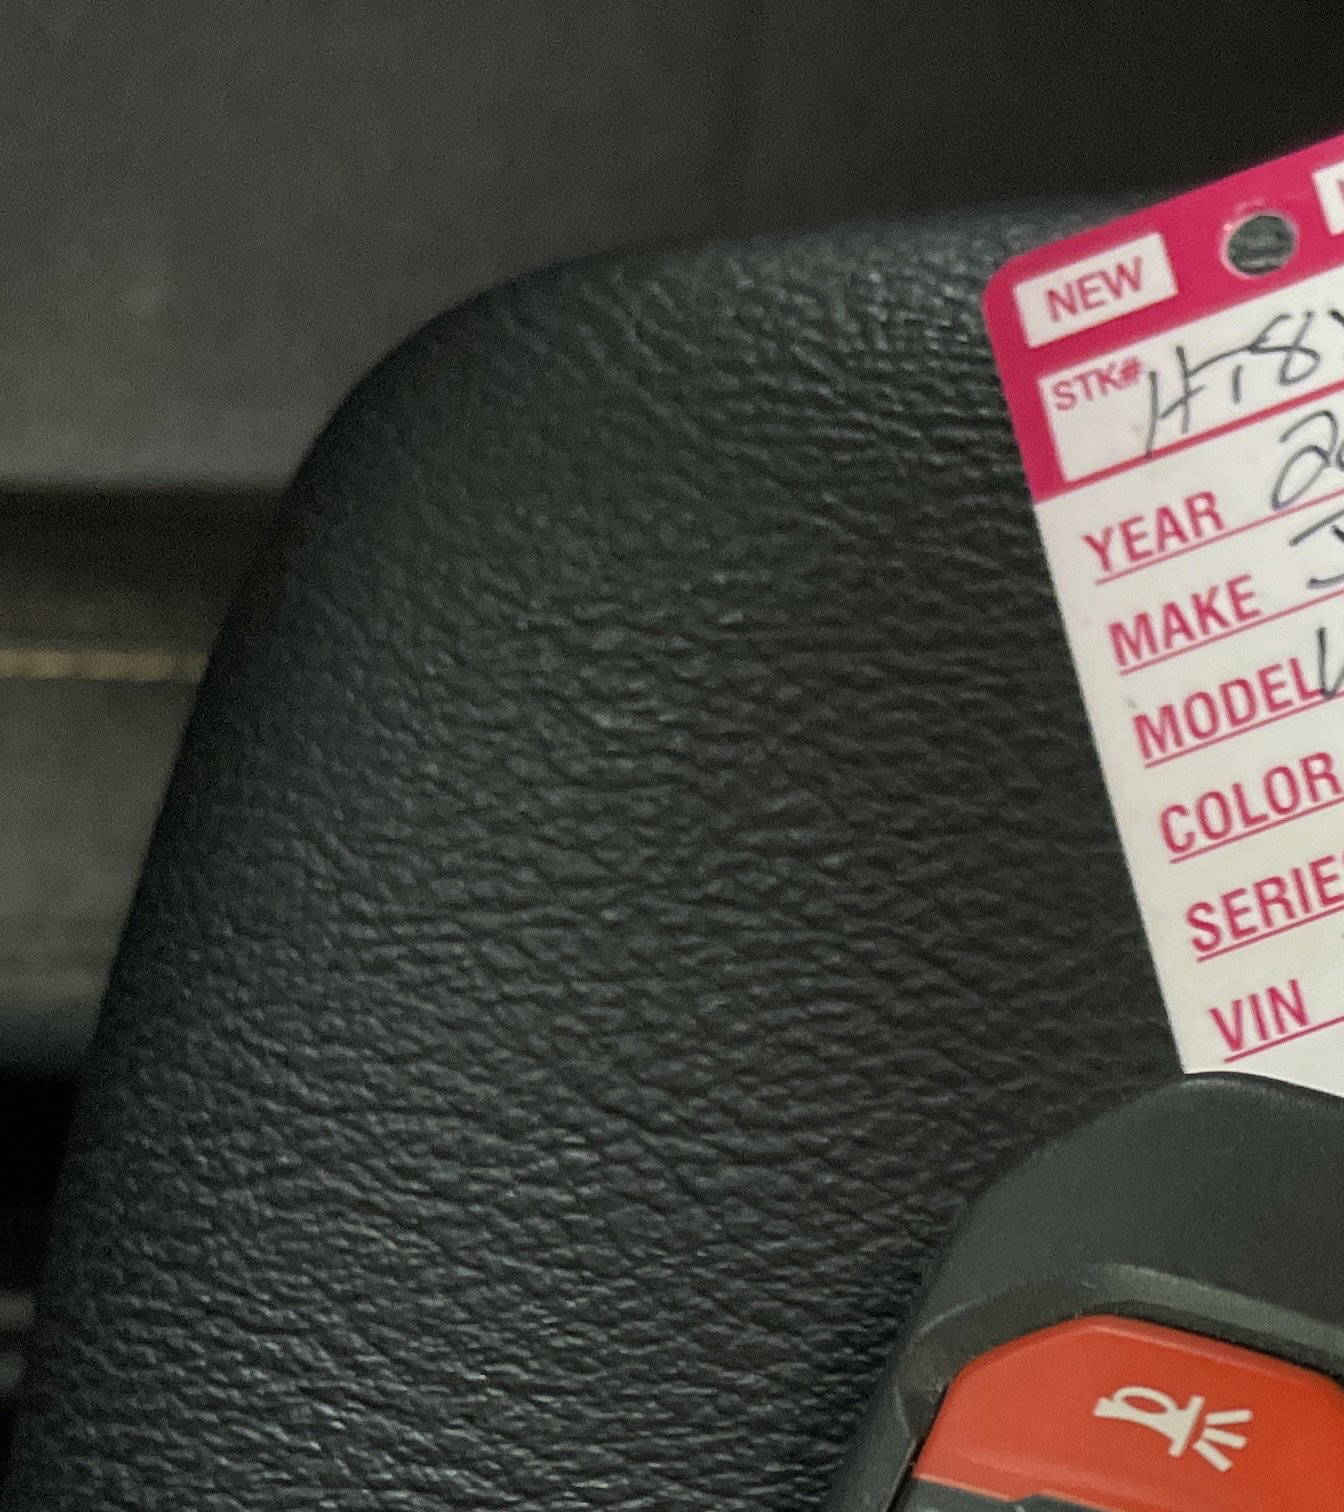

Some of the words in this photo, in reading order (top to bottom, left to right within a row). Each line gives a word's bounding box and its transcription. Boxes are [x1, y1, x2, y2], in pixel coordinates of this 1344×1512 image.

[1046, 257, 1144, 322] NEW
[1053, 358, 1145, 411] STK#
[1083, 491, 1226, 570] YEAR
[1108, 574, 1262, 667] MAKE
[1132, 658, 1325, 761] MODEL
[1160, 753, 1342, 854] COLOR
[1210, 979, 1310, 1052] VIN
